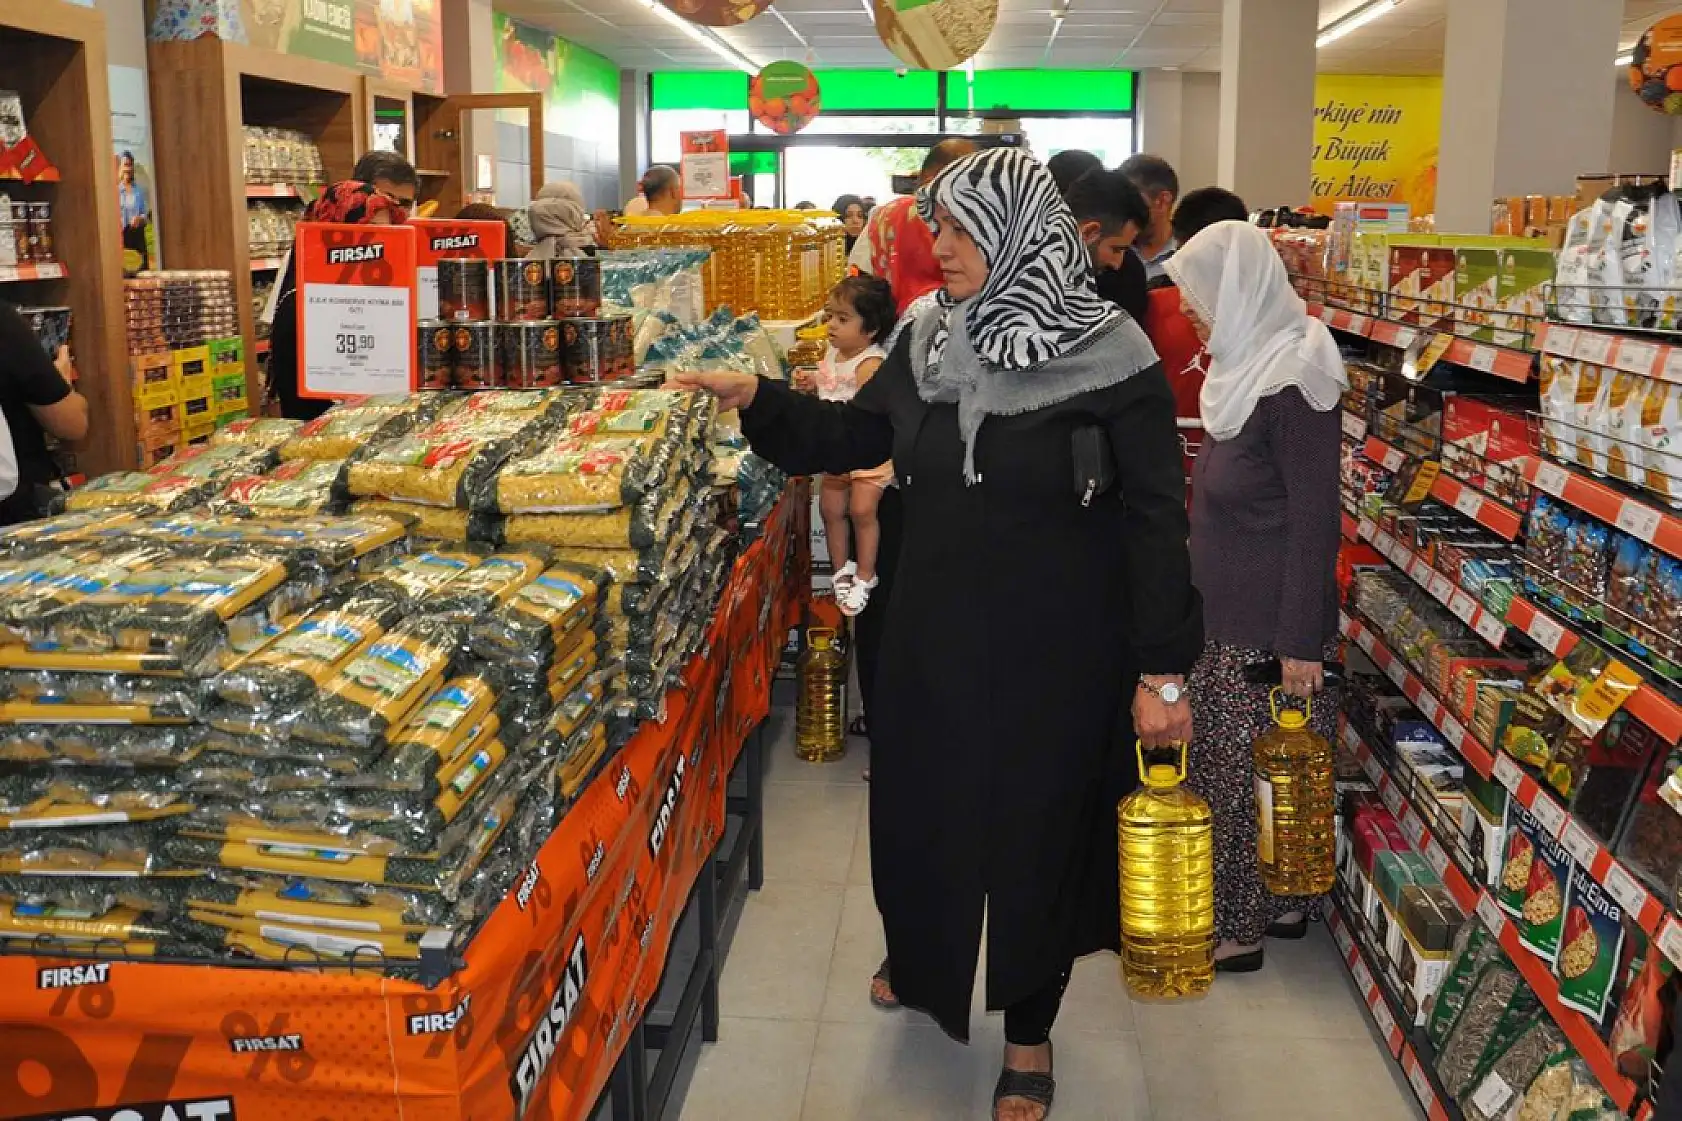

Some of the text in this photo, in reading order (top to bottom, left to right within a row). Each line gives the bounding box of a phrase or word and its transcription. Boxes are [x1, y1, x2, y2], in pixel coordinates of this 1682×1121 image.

[1324, 137, 1391, 170] Büyük
[1335, 175, 1396, 198] Ailesi
[330, 244, 384, 264] FIRSAT
[432, 234, 479, 251] FIRSAT
[41, 963, 109, 989] FIRSAT
[516, 933, 585, 1118] FIRSAT
[233, 1034, 300, 1053] FIRSAT
